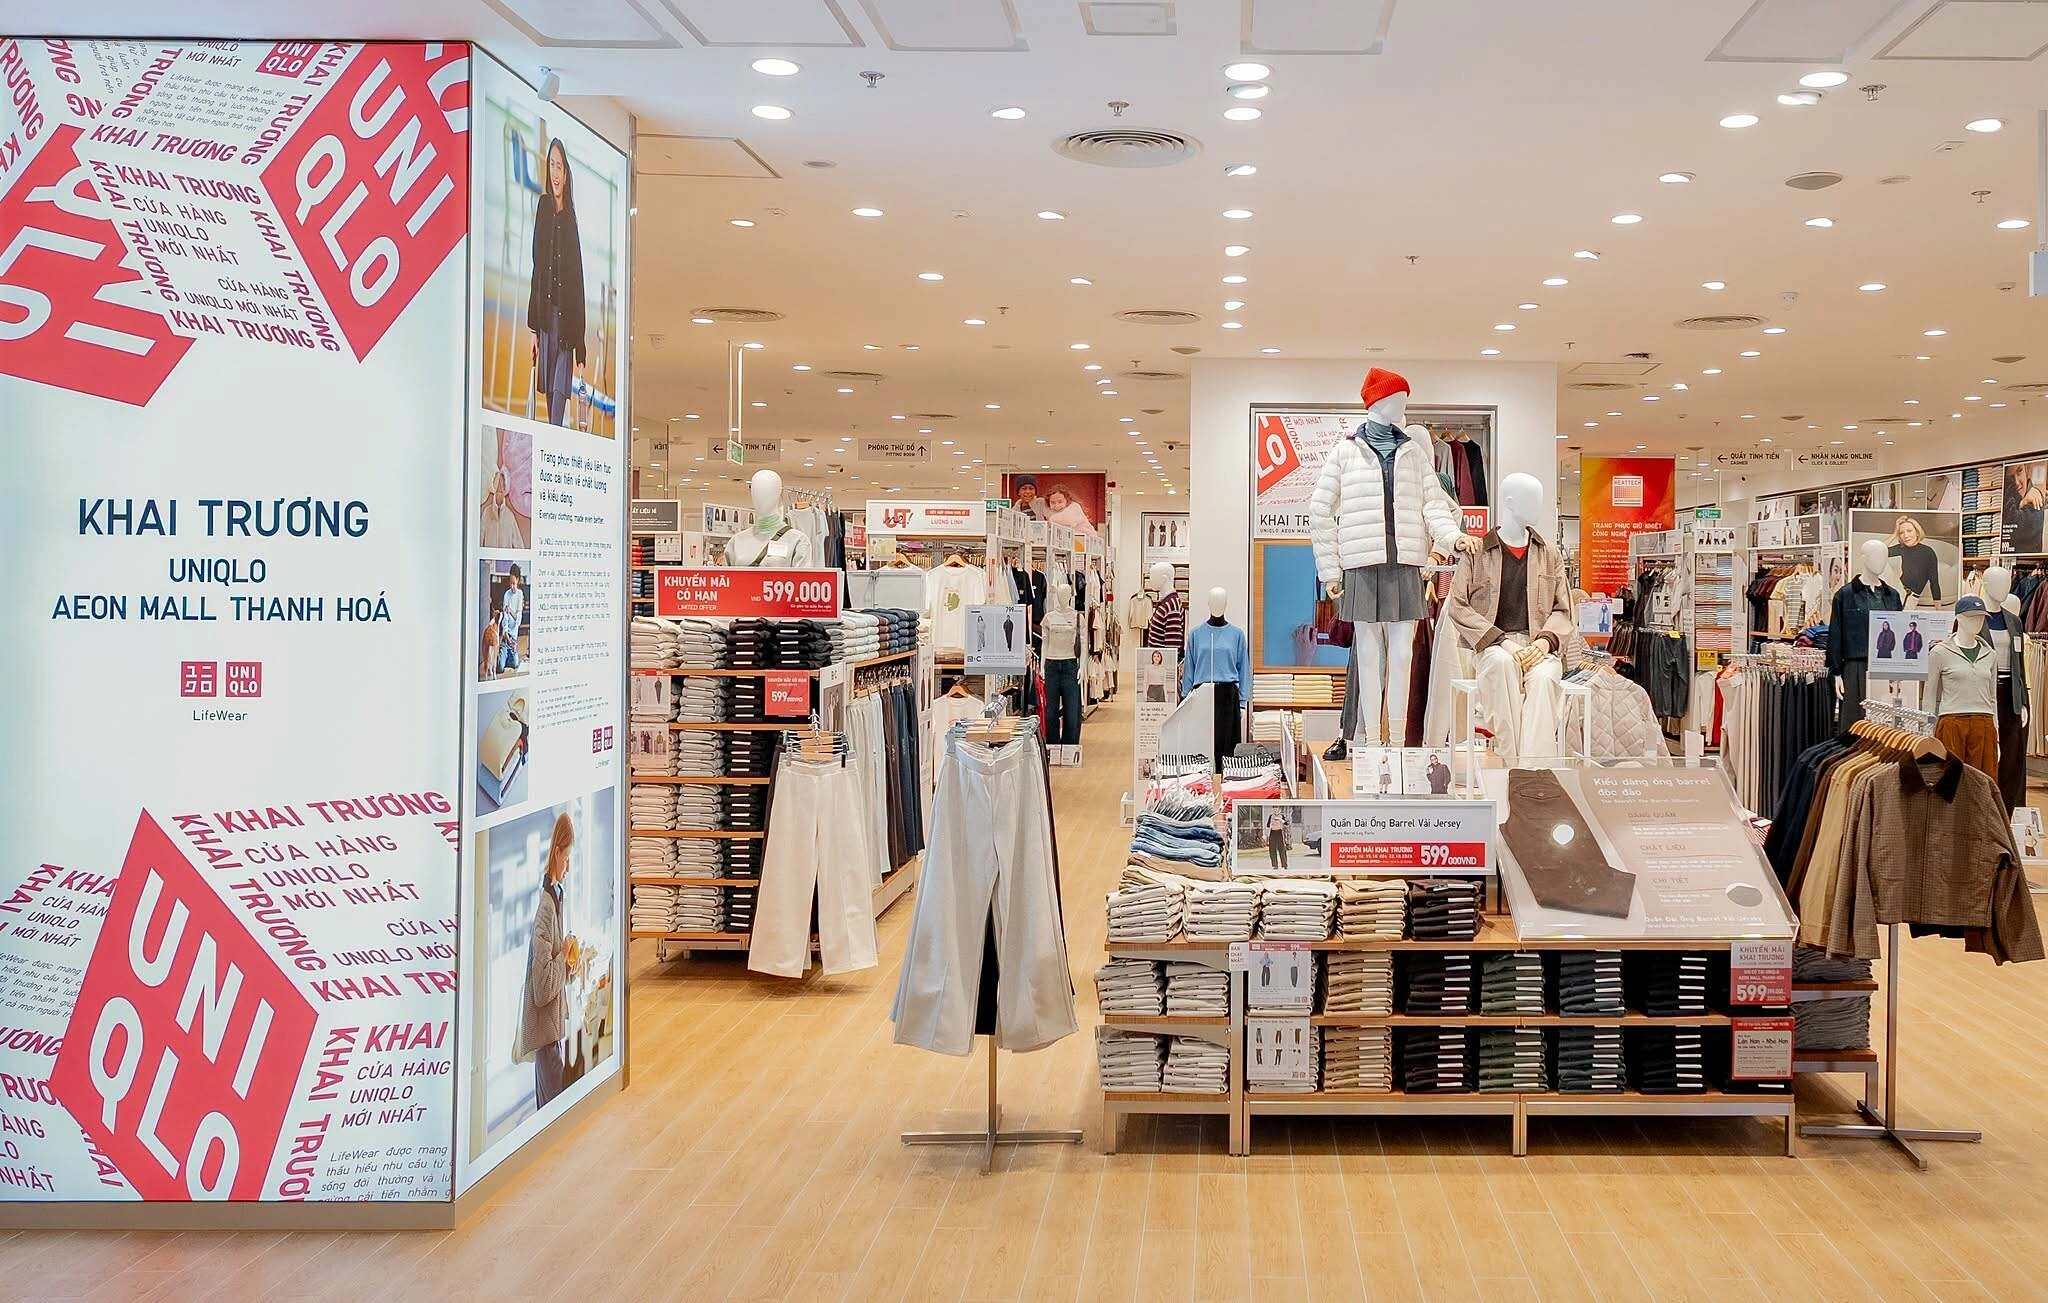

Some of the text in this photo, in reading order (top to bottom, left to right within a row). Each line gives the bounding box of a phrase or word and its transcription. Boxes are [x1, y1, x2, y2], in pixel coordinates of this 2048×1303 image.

[265, 56, 303, 72] QLO
[90, 125, 148, 148] KHAI
[89, 160, 132, 211] KHAI
[115, 165, 262, 206] KHAI TRƯƠNG
[142, 218, 209, 242] UNIQLO
[250, 210, 293, 261] KHAI
[183, 291, 234, 311] UNIQLO
[169, 309, 316, 349] KHAI TRƯƠNG
[79, 496, 369, 537] KHAI TRƯƠNG
[1260, 514, 1290, 527] KHAI
[169, 558, 266, 586] UNIQLO
[676, 588, 691, 601] CÓ
[763, 581, 832, 603] 599.000
[52, 590, 392, 622] AEON MALL THANH HOÁ
[185, 665, 213, 679] ユニ
[230, 666, 256, 679] UNI
[184, 681, 213, 694] クロ
[229, 680, 258, 696] QLO
[770, 690, 788, 702] 599
[193, 710, 248, 721] LifeWear
[214, 791, 452, 834] KHAI TRƯƠNG
[1389, 818, 1415, 828] Barrel
[1433, 818, 1462, 829] Jersey
[172, 814, 243, 870] KHAI
[315, 834, 398, 857] HÀNG
[1420, 845, 1449, 865] 599
[1448, 856, 1477, 865] 000VND
[262, 863, 370, 888] UNIQLO
[27, 911, 81, 929] UNIQLO
[332, 947, 414, 967] UNIQLO
[128, 866, 276, 1101] UNI
[310, 975, 402, 1002] KHAI
[1737, 984, 1767, 1001] 599
[364, 1021, 449, 1053] KHAI
[89, 996, 240, 1201] QLO
[350, 1085, 414, 1104] UNIQLO
[279, 1026, 360, 1201] KHAI TRƯƠ
[341, 1103, 428, 1128] MỚI NHẤT
[330, 1150, 379, 1162] LifeWear
[418, 1147, 448, 1158] mang
